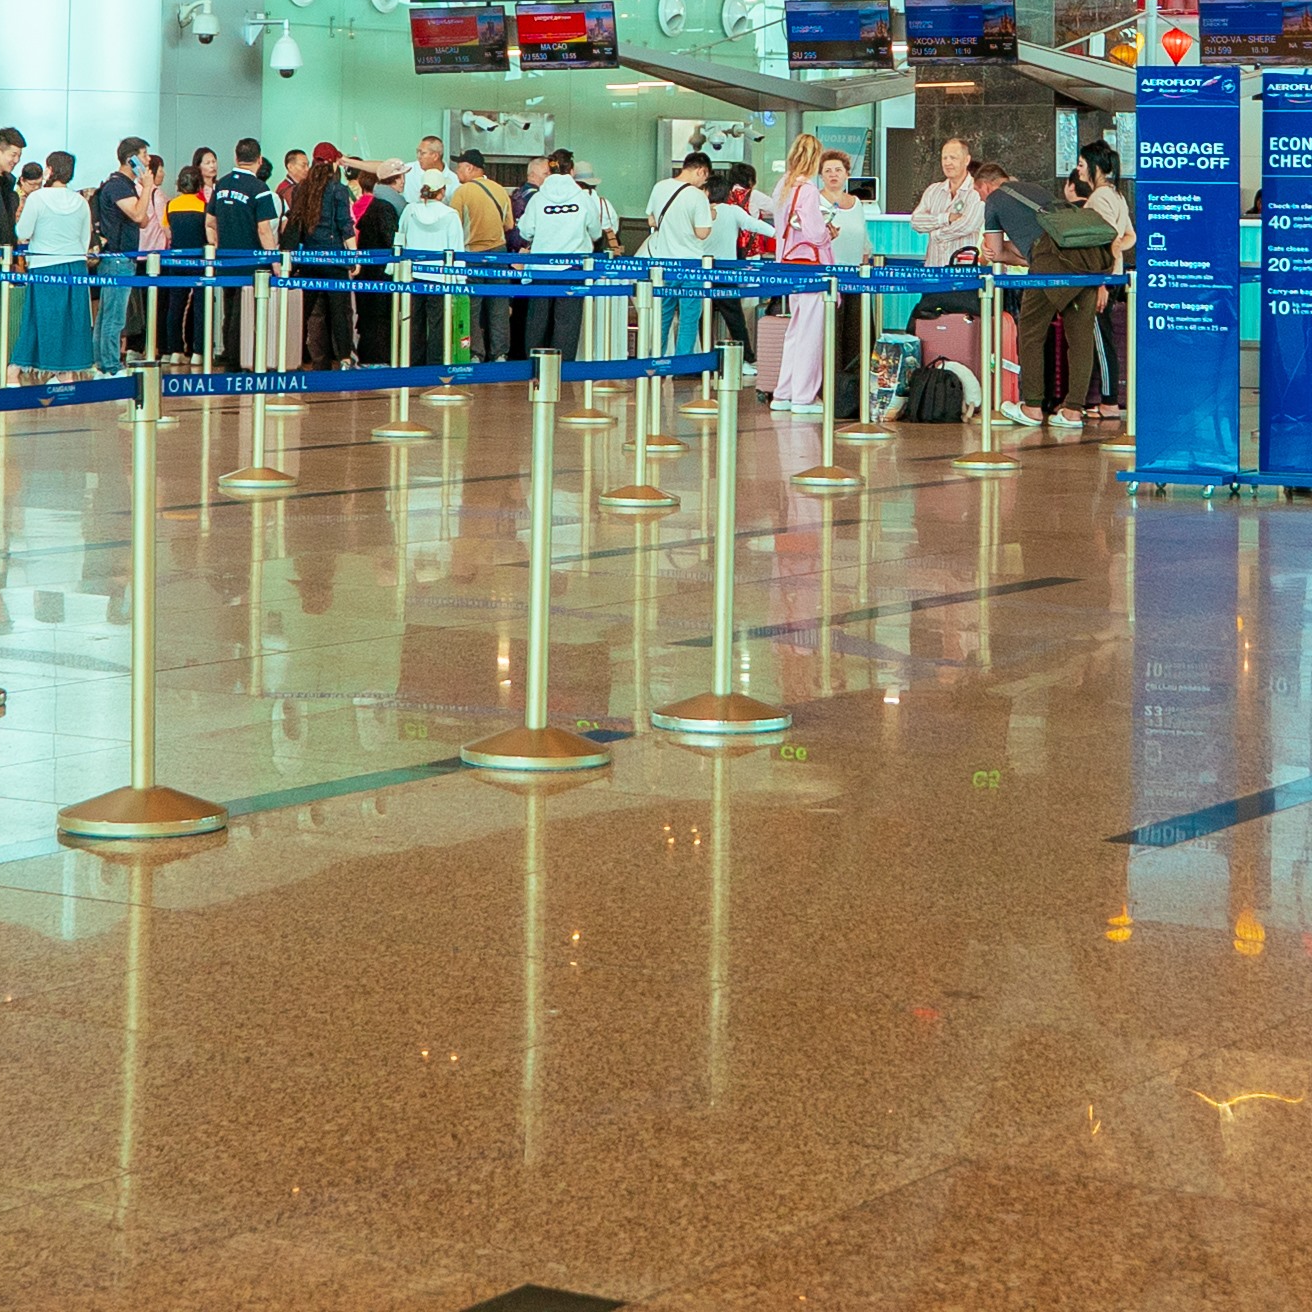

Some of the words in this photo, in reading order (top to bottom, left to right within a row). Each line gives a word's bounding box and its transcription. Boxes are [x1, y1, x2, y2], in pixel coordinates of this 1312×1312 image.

[951, 37, 977, 45] SHERE
[1207, 36, 1242, 44] -XCO-VA
[1248, 36, 1276, 44] SHERE
[792, 51, 803, 60] SU
[804, 51, 817, 59] 295
[1205, 47, 1216, 55] SU
[1218, 46, 1232, 54] 599
[522, 53, 530, 61] VJ
[1141, 78, 1202, 87] AEROFLOT
[1140, 142, 1224, 155] BAGGAGE
[1140, 157, 1230, 169] DROP-OFF
[1160, 194, 1201, 202] checked-in
[1148, 203, 1181, 212] Economy
[1148, 213, 1191, 221] passengers
[1268, 215, 1291, 229] 40
[1148, 259, 1179, 267] Checked
[1180, 260, 1211, 269] baggage
[1268, 258, 1290, 272] 20
[426, 266, 489, 277] INTERNATIONAL
[493, 269, 533, 278] TERMINAL
[72, 276, 118, 286] TERMINAL
[676, 273, 720, 282] CAMRANH
[724, 274, 794, 285] INTERNATIONAL
[1148, 274, 1167, 287] 23
[277, 278, 331, 288] CAMRANH
[335, 280, 418, 293] INTERNATIONAL
[423, 283, 476, 295] TERMINAL
[879, 284, 908, 293] TERMINAL
[709, 288, 741, 298] TERMINAL
[1148, 301, 1180, 310] Carry-on
[1181, 302, 1214, 311] baggage
[1268, 300, 1290, 315] 10
[1148, 316, 1165, 330] 10
[226, 375, 308, 391] TERMINAL
